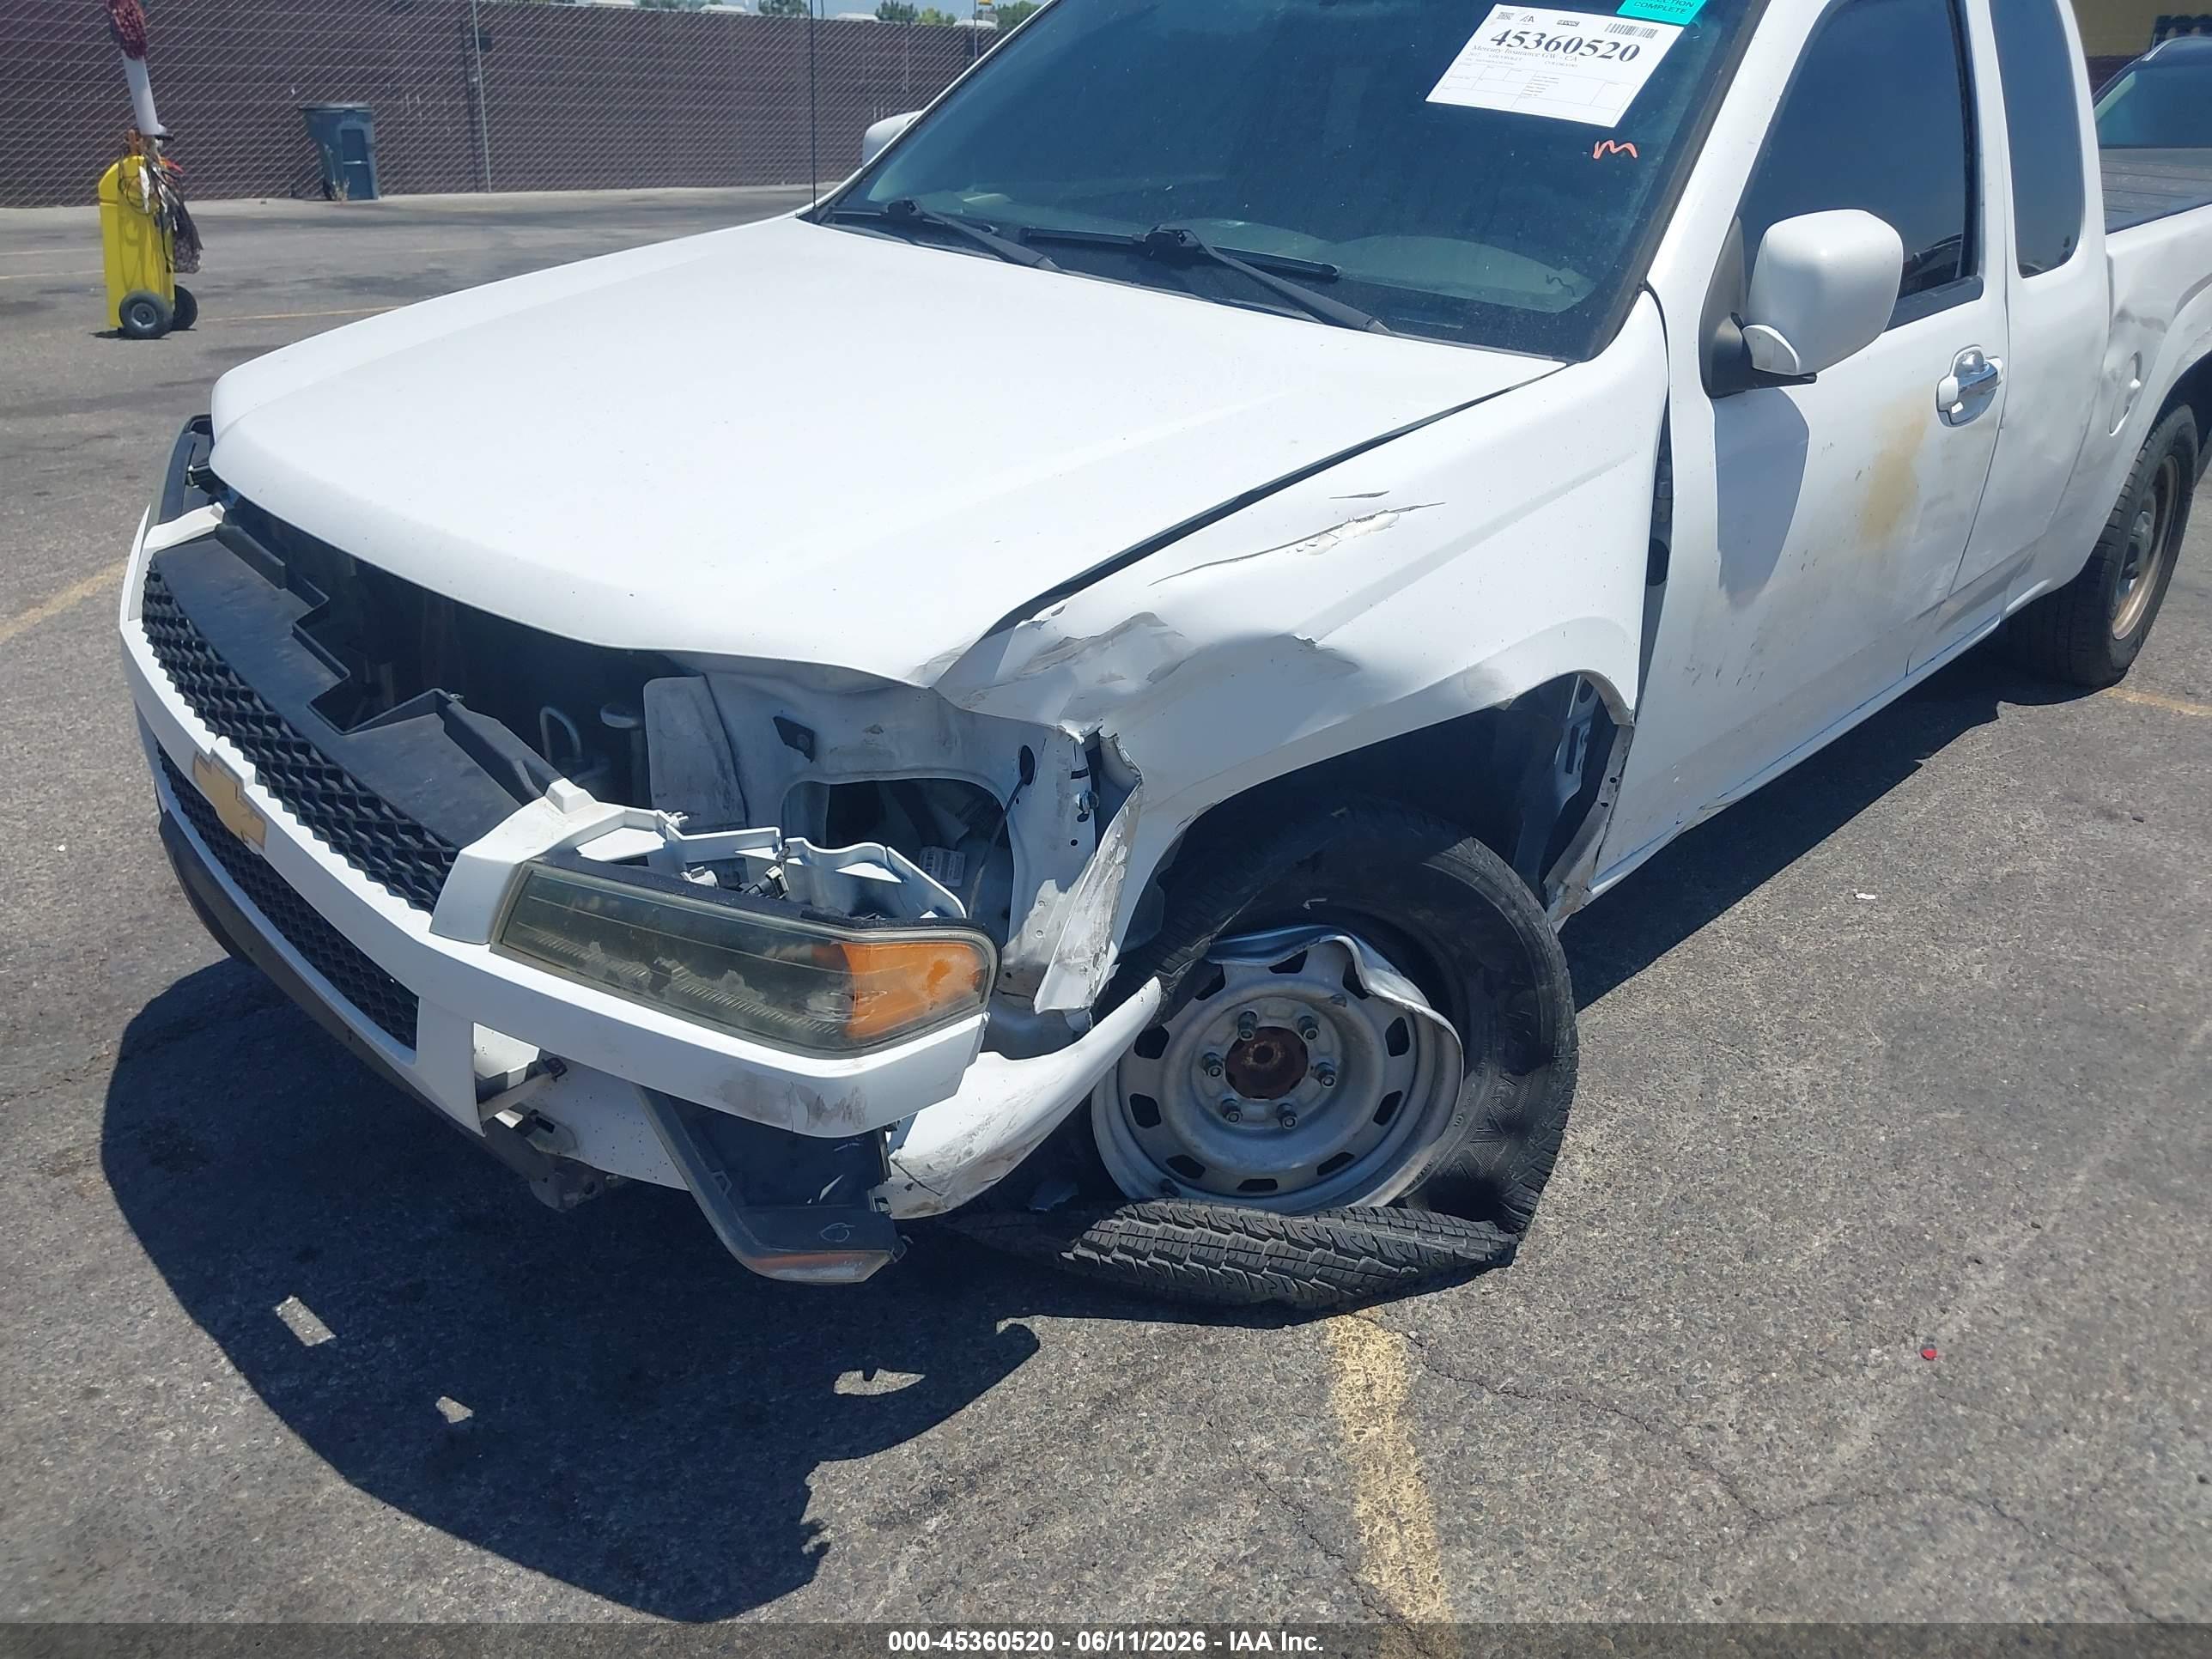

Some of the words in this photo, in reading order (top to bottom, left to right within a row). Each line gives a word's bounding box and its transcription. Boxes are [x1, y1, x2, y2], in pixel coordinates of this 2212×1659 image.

[1633, 1, 1689, 15] COMPLETE
[1472, 45, 1502, 54] Mercury
[1504, 47, 1540, 58] Insurance
[1490, 28, 1640, 63] 45360520
